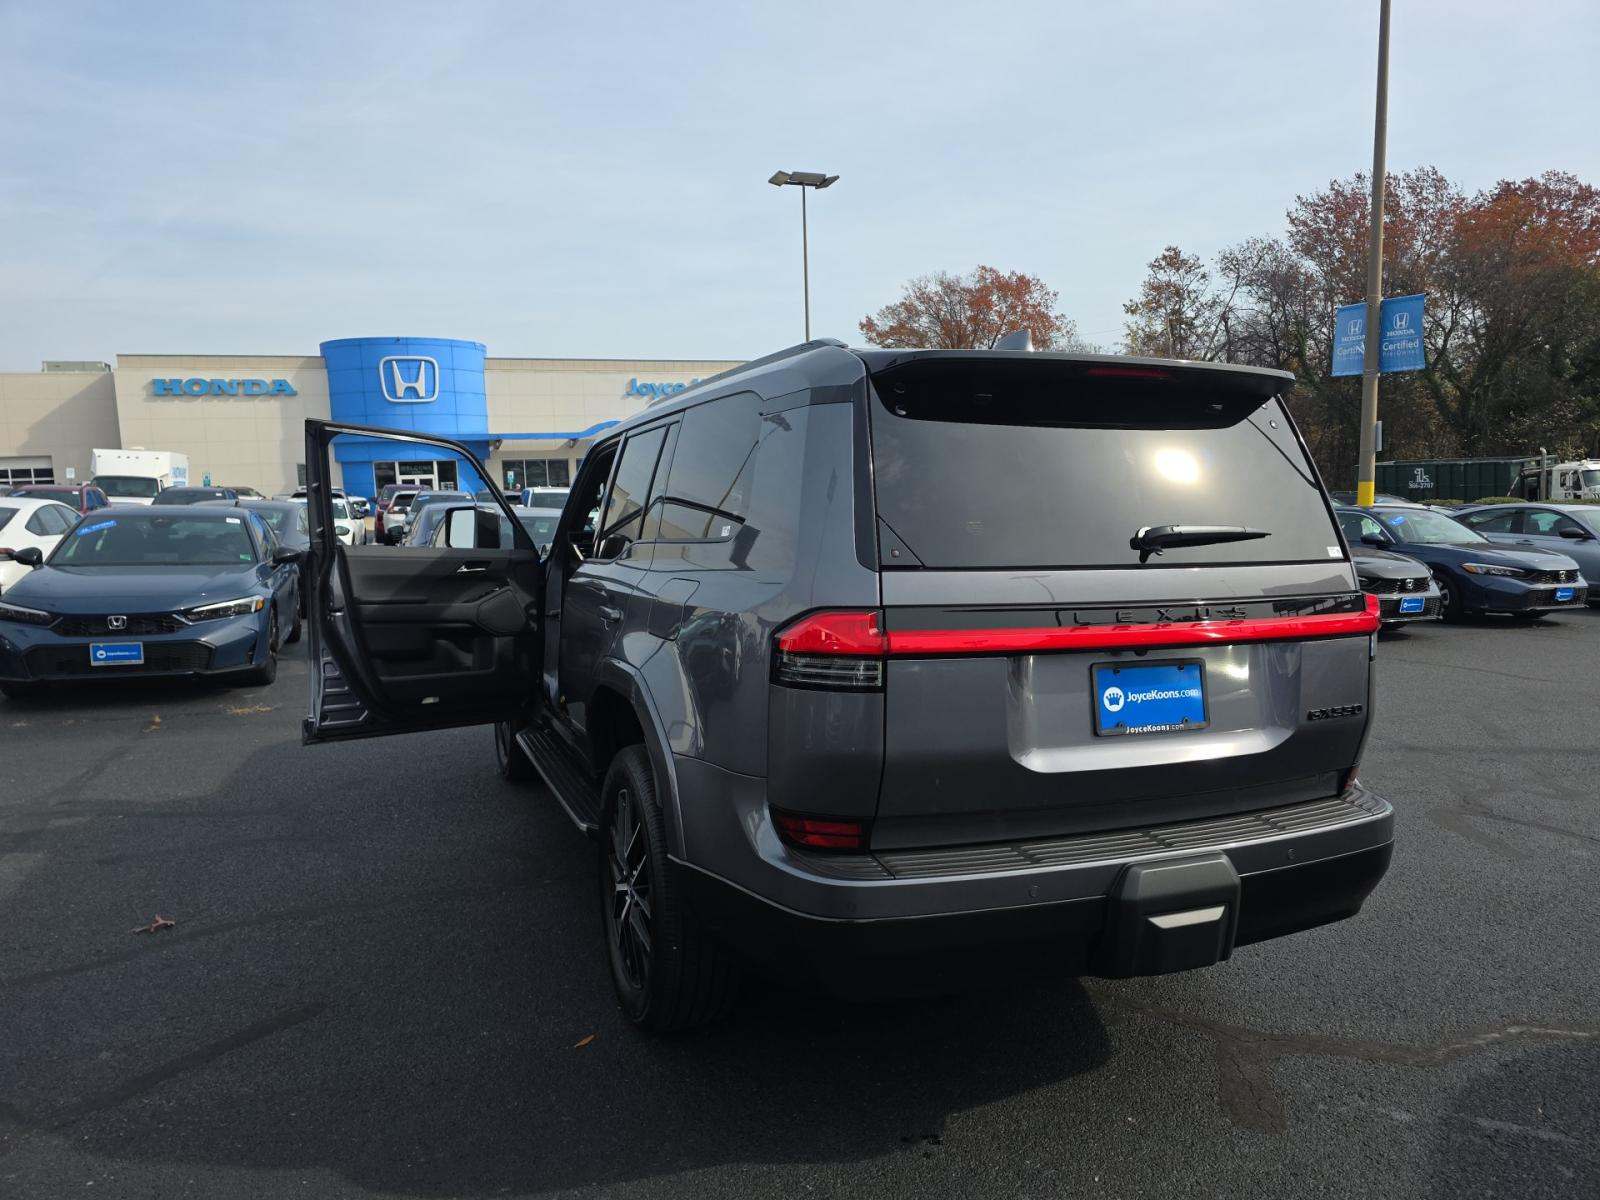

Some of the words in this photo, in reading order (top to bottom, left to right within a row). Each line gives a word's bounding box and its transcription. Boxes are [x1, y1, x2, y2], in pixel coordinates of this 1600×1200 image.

[1386, 328, 1415, 337] HONDA
[1382, 339, 1419, 351] Certified
[151, 378, 298, 397] HONDA
[624, 378, 687, 400] Joyce
[1073, 606, 1246, 626] LEXUS
[1127, 687, 1200, 703] JoyceKoons.com
[1126, 723, 1185, 734] JoyceKoons.com
